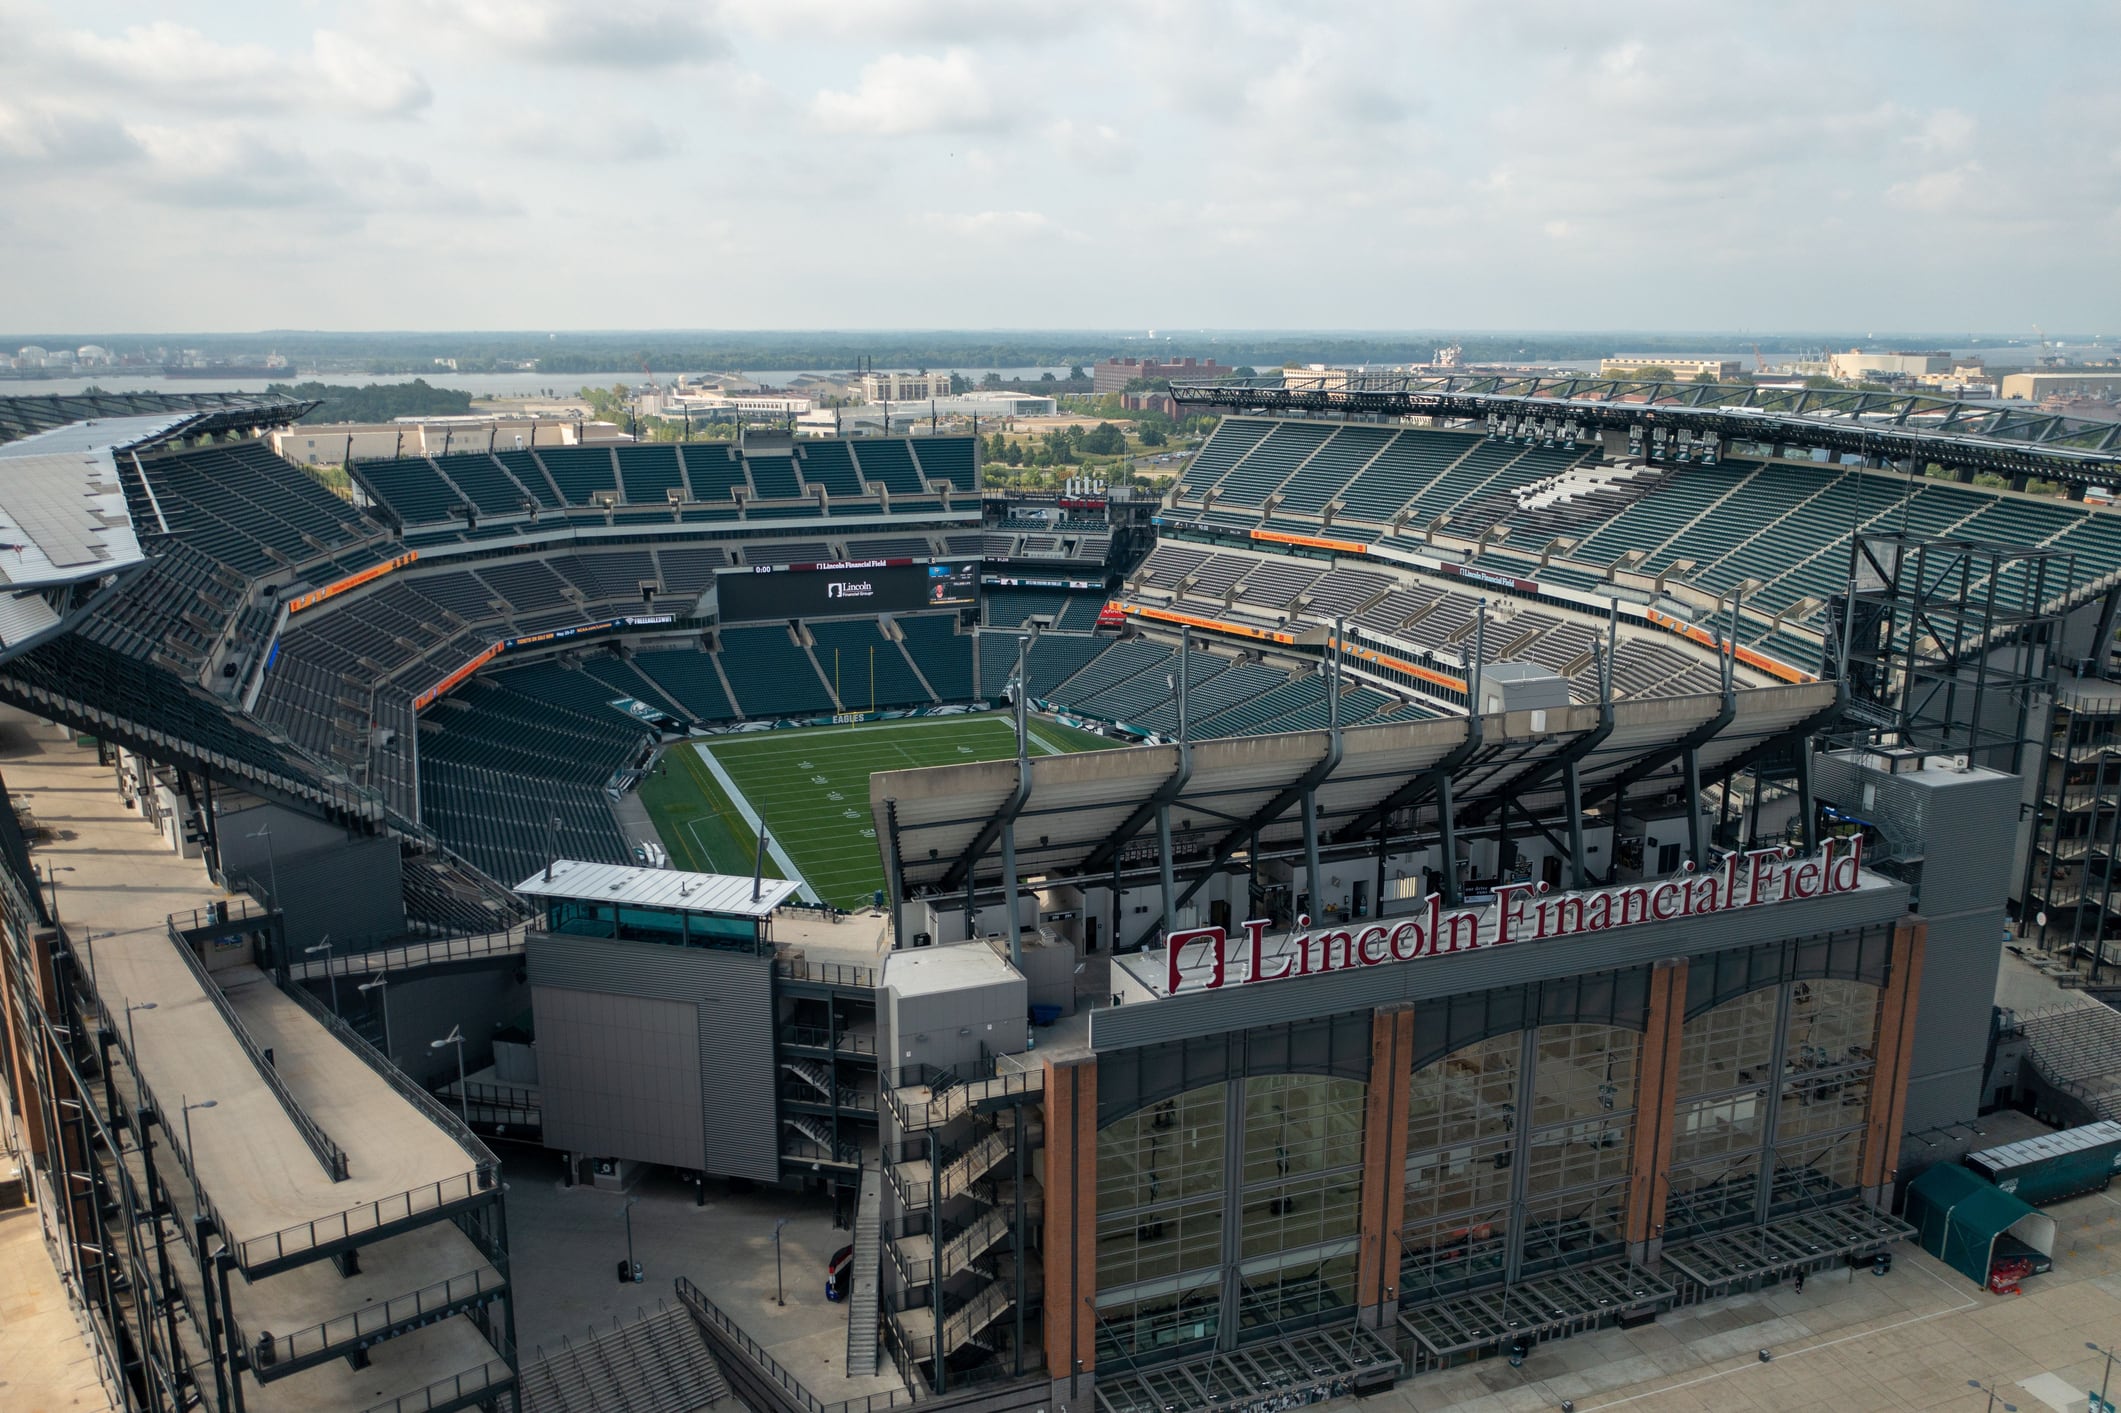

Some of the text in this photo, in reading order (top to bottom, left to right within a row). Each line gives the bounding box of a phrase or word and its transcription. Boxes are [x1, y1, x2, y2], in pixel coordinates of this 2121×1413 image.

[1066, 475, 1104, 500] Lite
[755, 566, 771, 574] 0:00
[823, 562, 845, 570] Lincoln
[845, 561, 871, 569] Financial
[843, 581, 872, 591] Lincoln
[832, 712, 864, 725] EAGLES
[1240, 833, 1864, 985] Lincoln Financial Field
[1489, 1302, 1637, 1345] RED ZONE SUITES
[1264, 1387, 1298, 1401] PRO
[1313, 1372, 1359, 1389] SHOP
